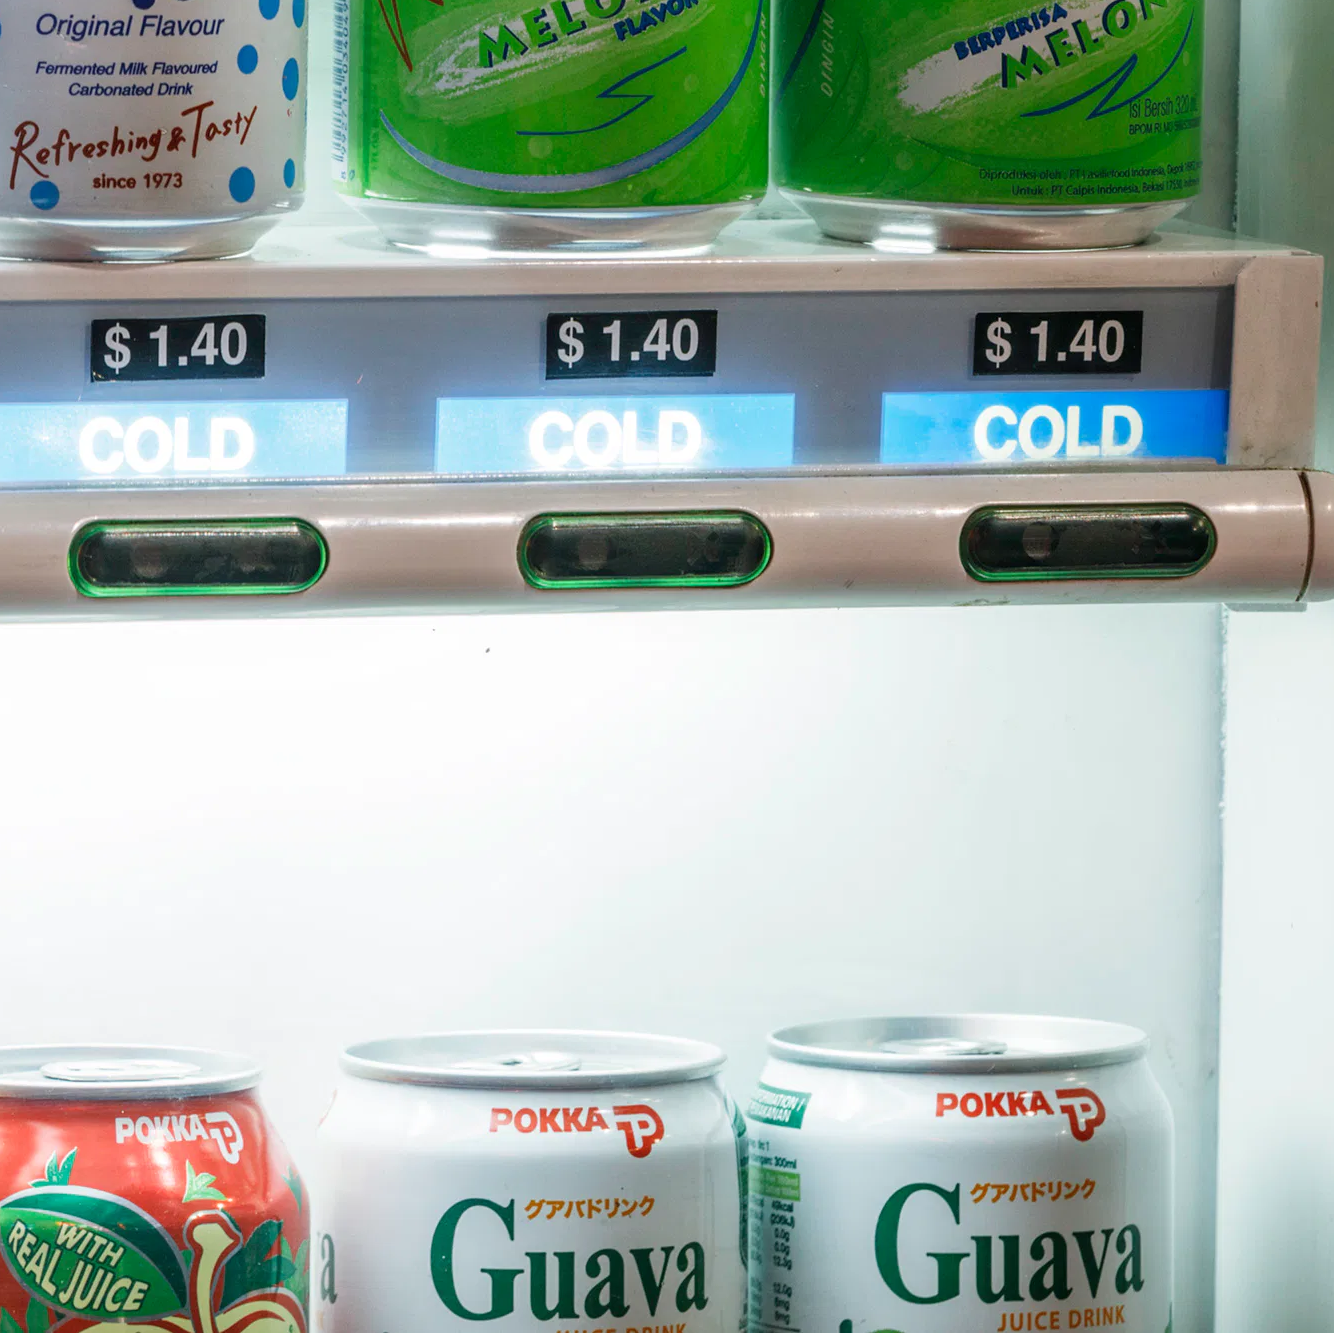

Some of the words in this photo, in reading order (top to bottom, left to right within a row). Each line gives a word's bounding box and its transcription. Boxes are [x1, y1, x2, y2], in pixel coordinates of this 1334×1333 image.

[35, 12, 131, 42] Original
[139, 14, 225, 37] Flavour
[953, 3, 1068, 60] BERPERISA
[35, 61, 115, 76] Fermented
[118, 61, 148, 76] Milk
[151, 61, 218, 76] Flavoured
[68, 82, 154, 97] Carbonated
[157, 82, 193, 96] Drink
[9, 120, 162, 190] Refreshing
[167, 131, 187, 152] &
[181, 100, 258, 158] Tasty
[92, 174, 137, 190] since
[144, 173, 183, 189] 1973
[104, 323, 131, 375] $
[149, 322, 248, 366] 1.40
[557, 318, 584, 369] $
[602, 318, 700, 363] 1.40
[985, 319, 1011, 369] $
[1029, 320, 1125, 364] 1.40
[78, 417, 255, 474] COLD
[529, 409, 702, 466] COLD
[973, 405, 1143, 459] COLD
[490, 1106, 609, 1133] POKKA
[936, 1090, 1054, 1117] POKKA
[116, 1115, 209, 1144] POKKA
[524, 1195, 655, 1220] グアバドリンク
[970, 1178, 1097, 1203] グアバドリンク
[7, 1219, 59, 1297] REAL
[59, 1259, 151, 1314] JUICE
[56, 1220, 125, 1267] WITH
[430, 1197, 709, 1322] Guava
[874, 1182, 1145, 1306] Guava
[997, 1310, 1060, 1332] JUICE
[1067, 1305, 1125, 1328] DRINK
